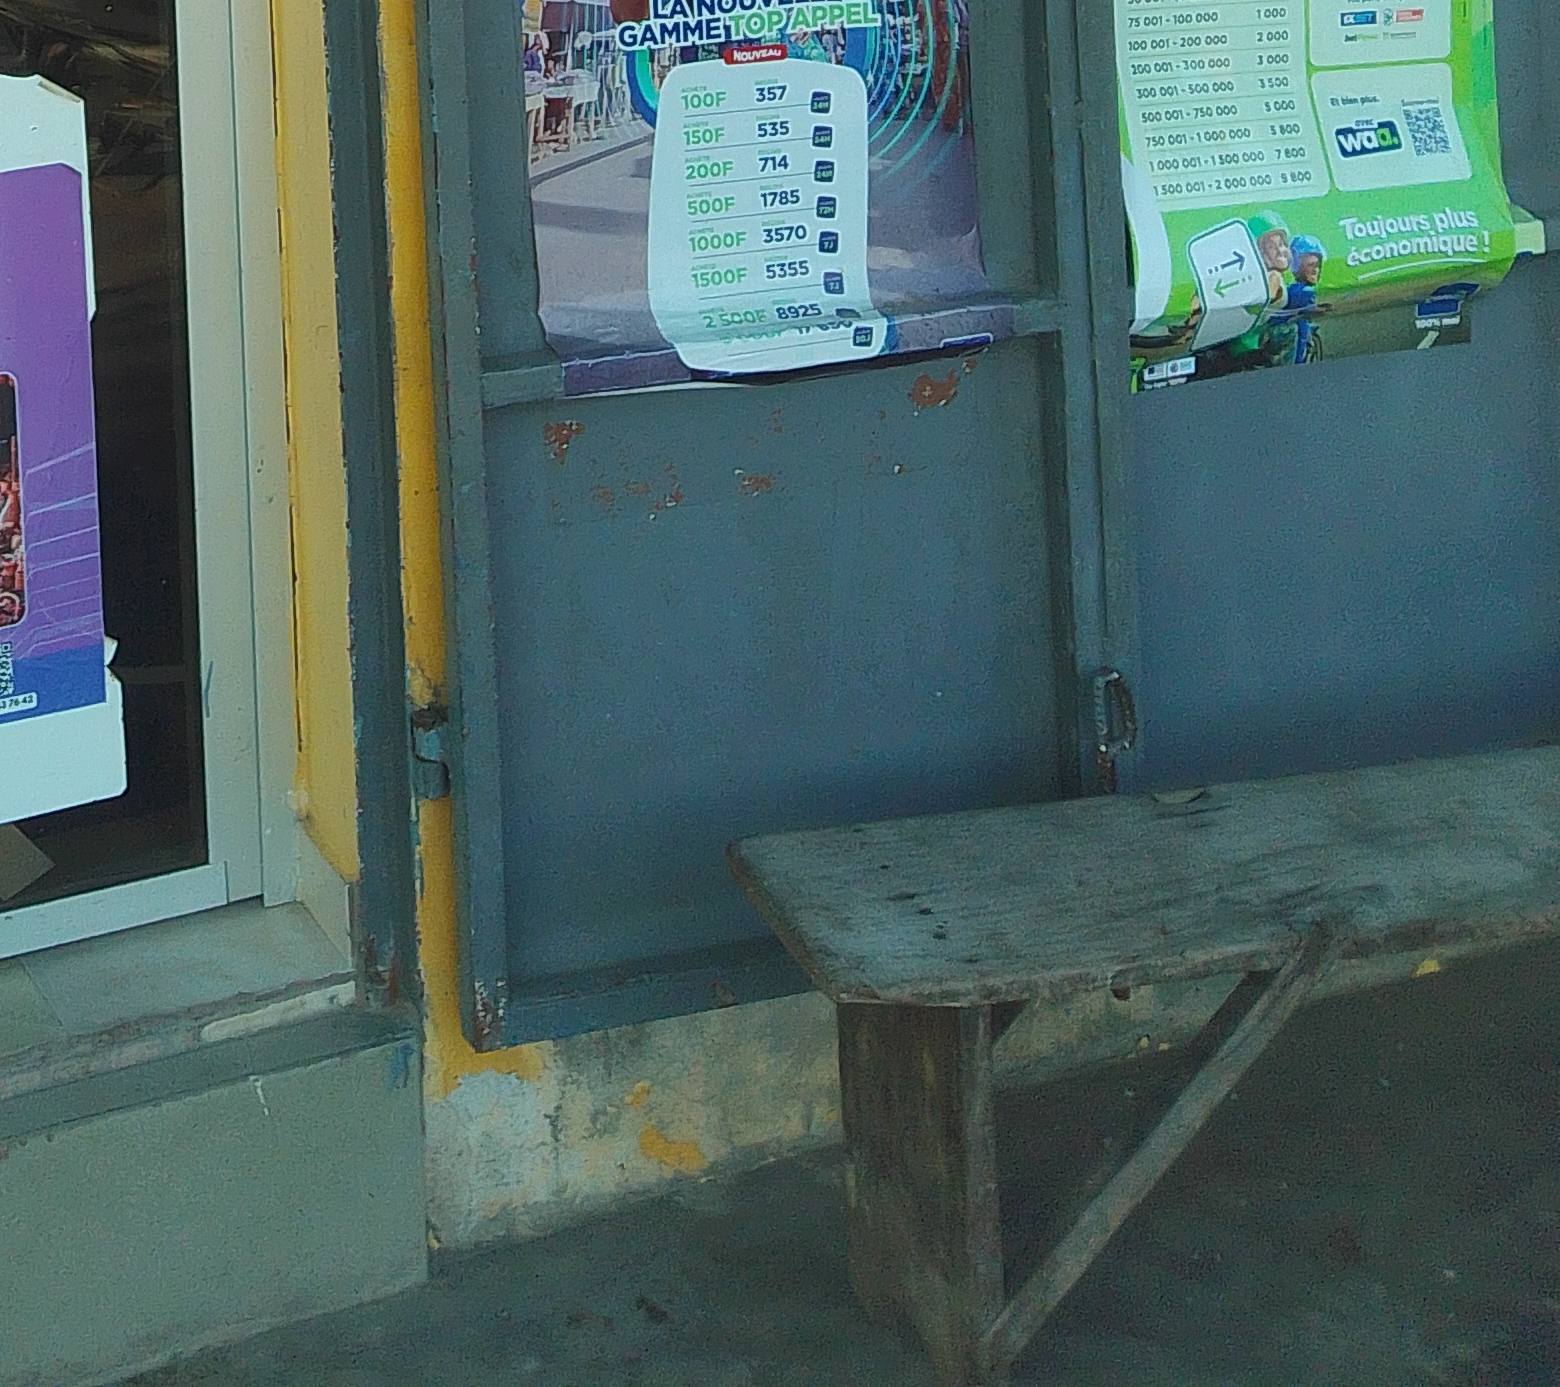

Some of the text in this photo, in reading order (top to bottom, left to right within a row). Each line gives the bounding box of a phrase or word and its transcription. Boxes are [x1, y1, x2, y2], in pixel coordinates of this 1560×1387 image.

[617, 1, 878, 48] GAMME TOP APPEL
[732, 47, 782, 62] NOUVEAU
[681, 91, 726, 110] 100F
[756, 85, 787, 102] 357
[683, 127, 725, 145] 150F
[757, 121, 789, 138] 535
[685, 161, 733, 179] 200F
[758, 155, 789, 172] 714
[1339, 207, 1478, 240] Toujours plus
[690, 231, 747, 252] 1000F
[763, 225, 807, 243] 3570
[1347, 231, 1478, 266] économique
